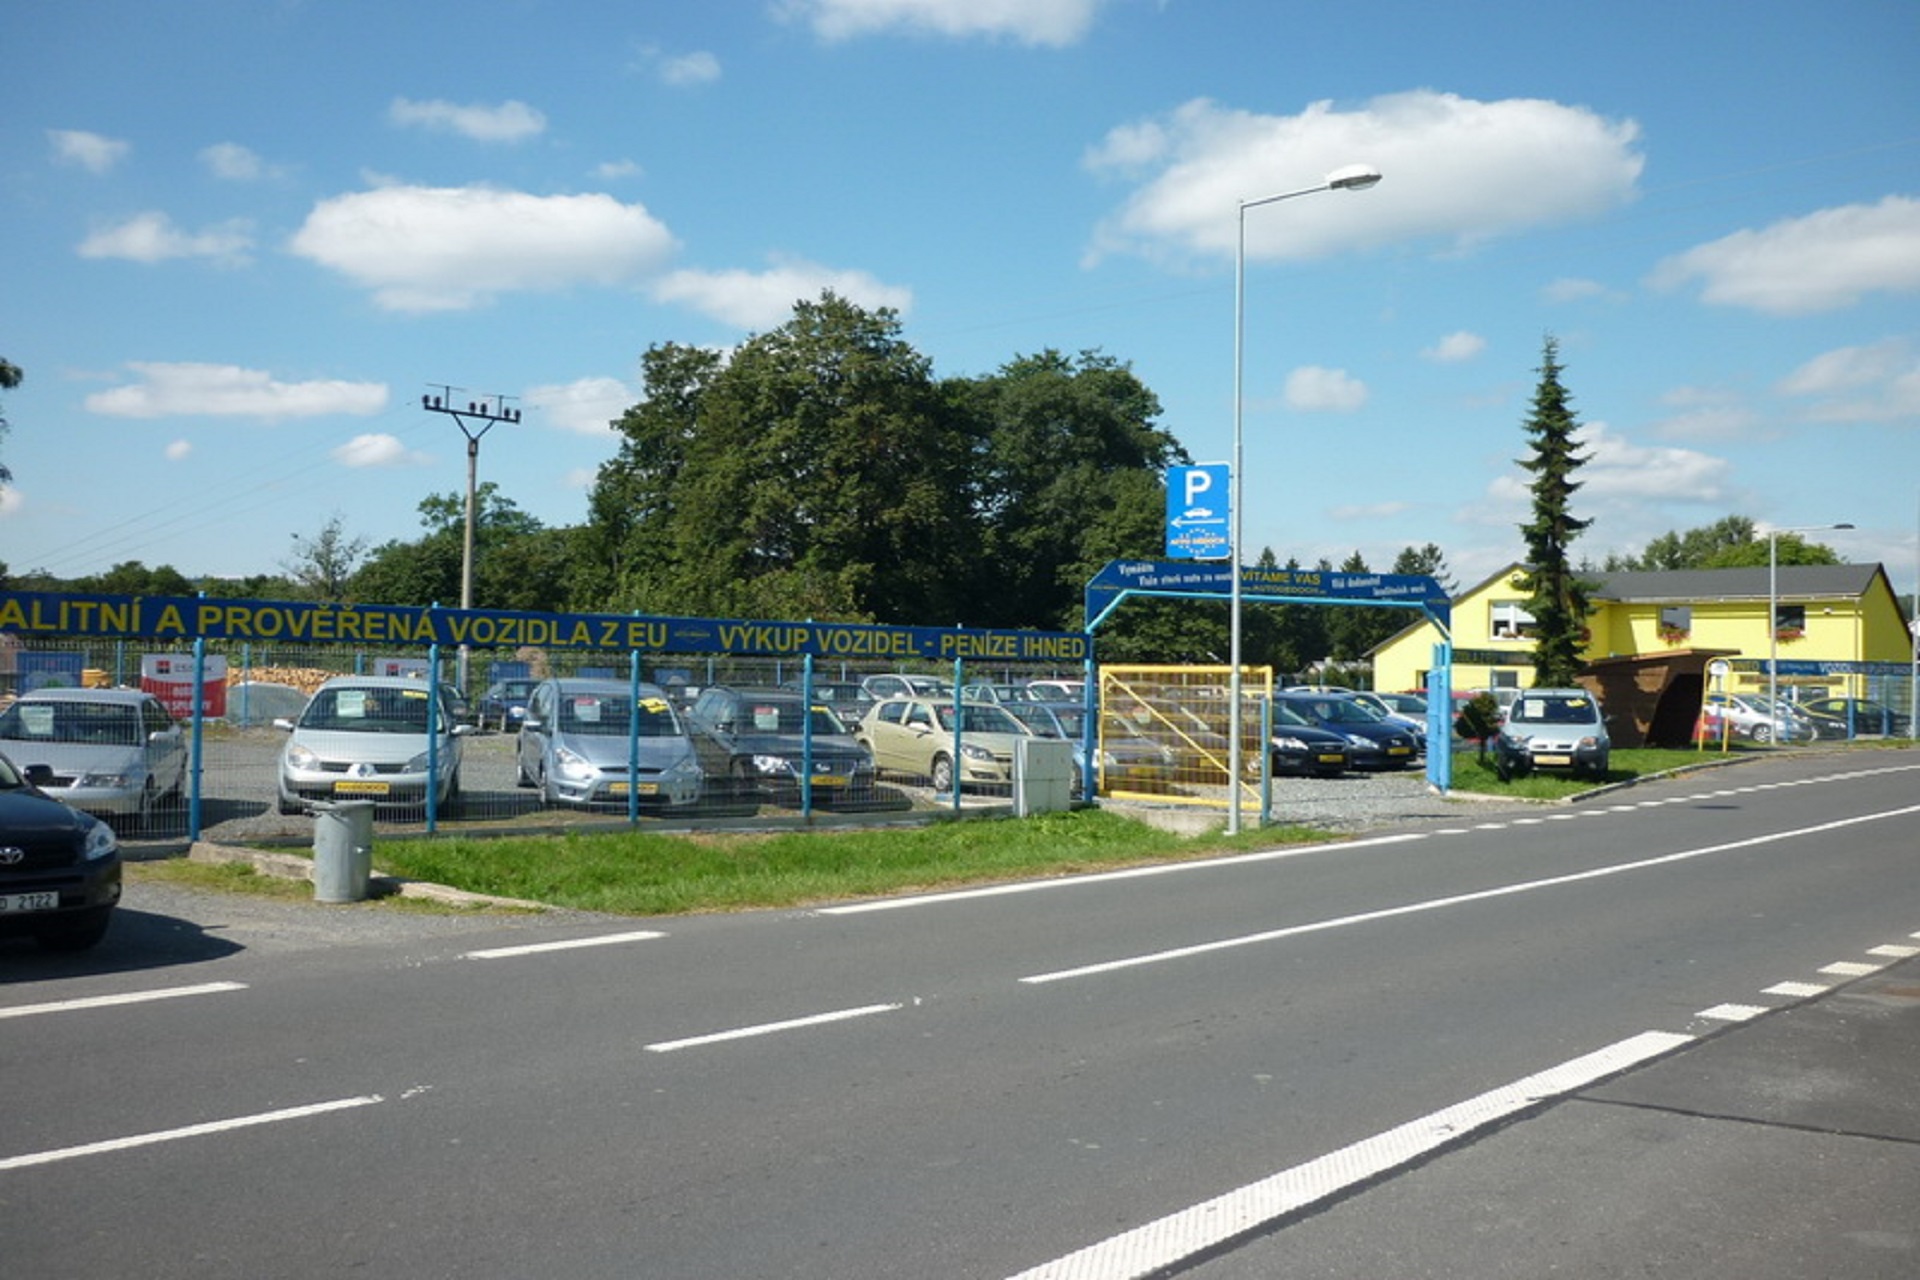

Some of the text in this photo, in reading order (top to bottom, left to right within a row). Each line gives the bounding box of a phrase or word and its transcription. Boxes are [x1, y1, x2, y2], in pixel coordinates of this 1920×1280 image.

[1185, 471, 1212, 506] P
[0, 597, 667, 648] ALITNÍ A PROVĚŘENÁ VOZIDLA Z EU
[718, 620, 810, 651] VÝKUP
[815, 628, 921, 655] VOZIDEL
[940, 630, 1019, 657] PENÍZE
[1023, 637, 1085, 659] IHNED
